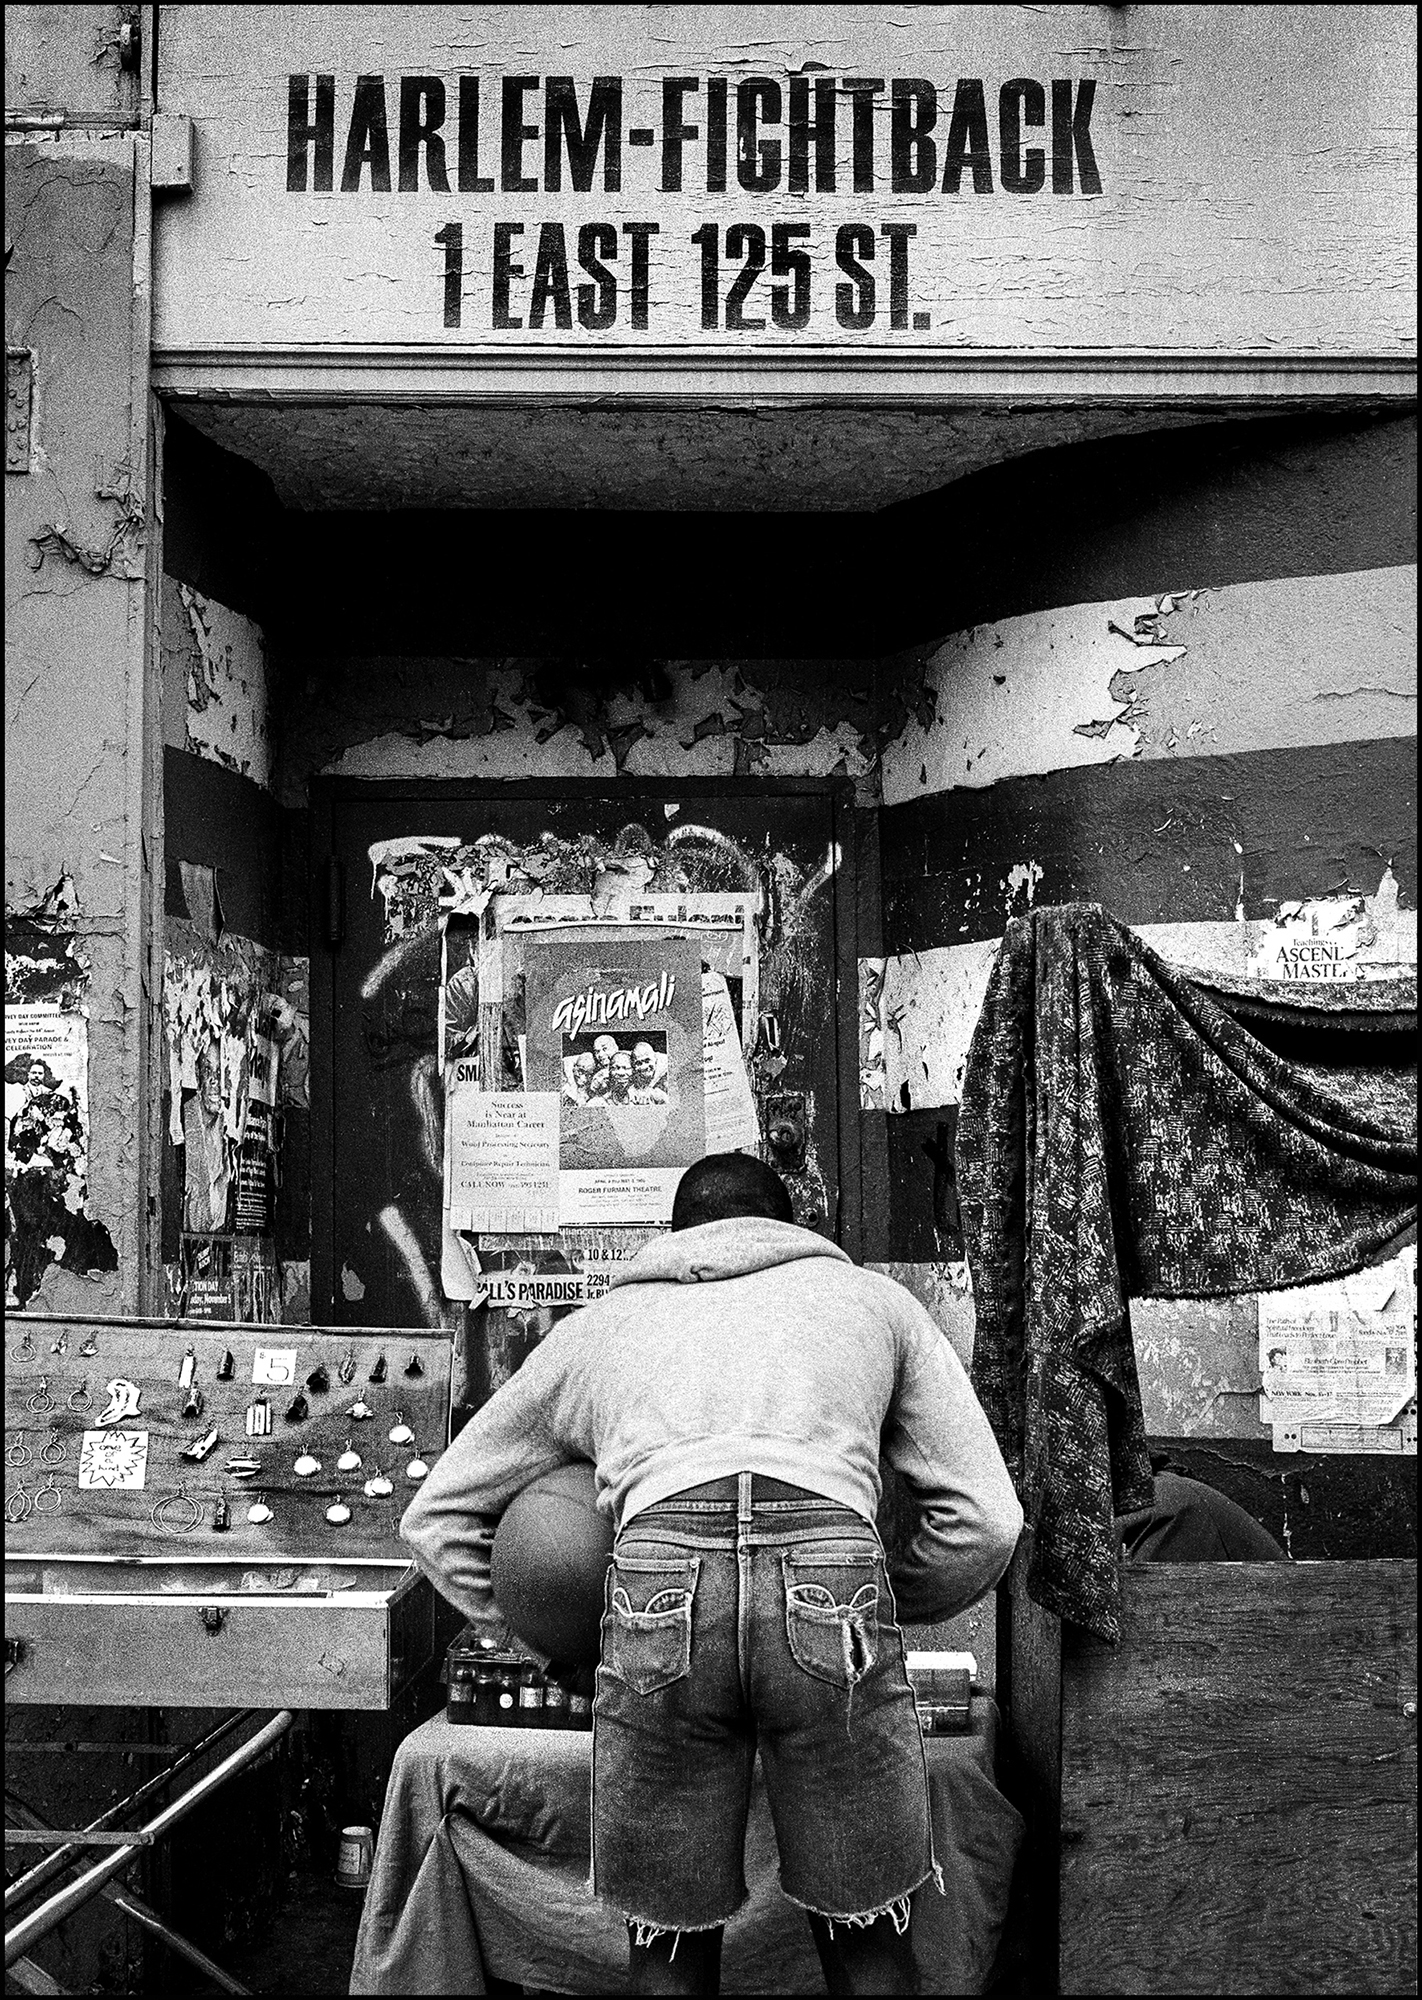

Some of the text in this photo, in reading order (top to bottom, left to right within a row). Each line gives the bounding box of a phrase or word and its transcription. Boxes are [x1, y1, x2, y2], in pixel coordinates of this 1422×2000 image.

[286, 74, 1102, 194] HARLEM-FIGHTBACK
[434, 222, 931, 330] 1 EAST 125 ST.
[485, 1110, 492, 1118] is
[496, 1110, 515, 1118] Near
[467, 1120, 545, 1128] Manhattan Career
[588, 1249, 599, 1260] 10
[602, 1249, 609, 1260] &
[518, 1282, 583, 1300] PARADISE
[99, 1444, 121, 1452] one
